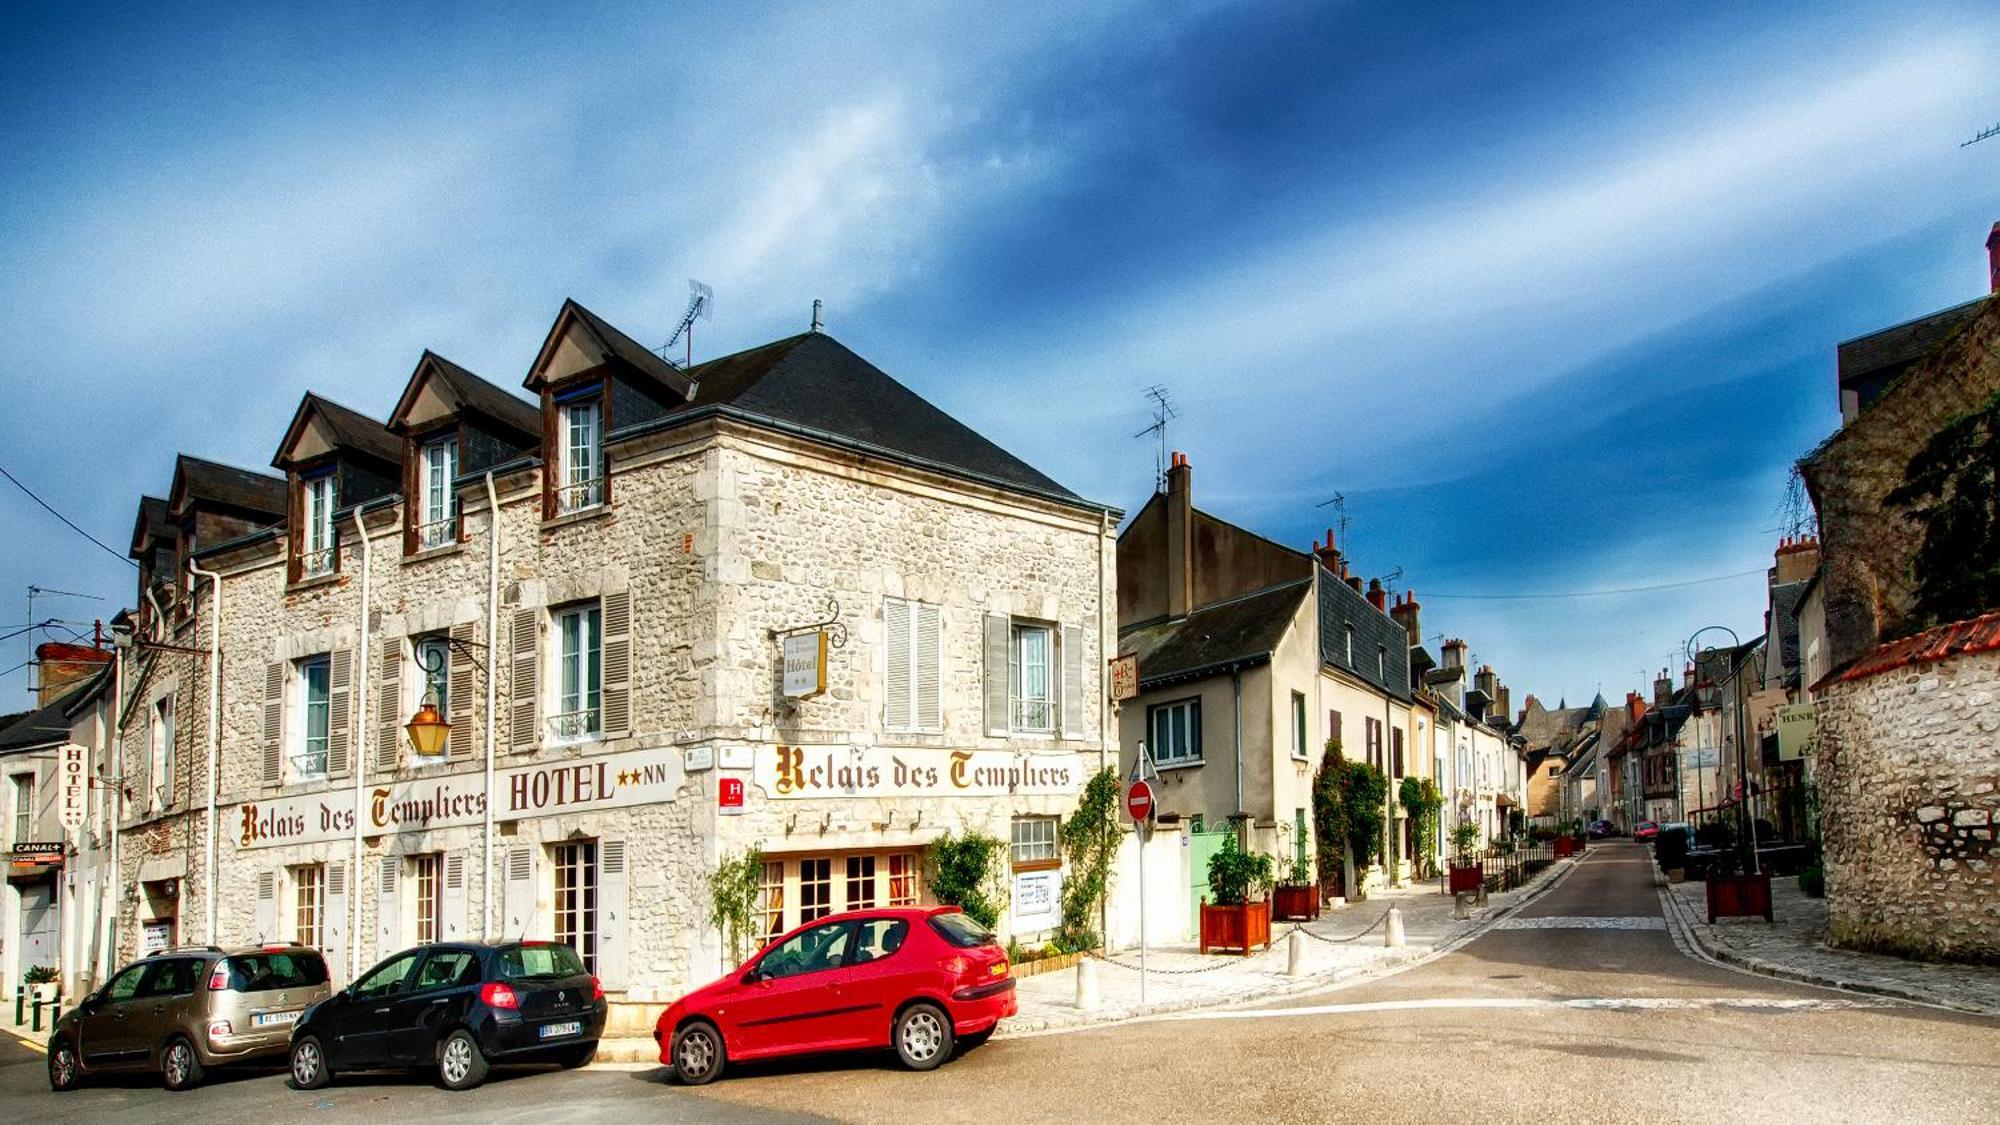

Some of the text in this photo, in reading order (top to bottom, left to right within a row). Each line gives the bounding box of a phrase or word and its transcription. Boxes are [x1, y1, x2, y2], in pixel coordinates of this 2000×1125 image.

[786, 655, 817, 673] Hôtel
[1783, 712, 1815, 723] HENR
[66, 750, 81, 809] HOTEL
[509, 762, 666, 811] HOTEL NN
[776, 746, 1070, 794] Relais des Templiers
[729, 783, 741, 795] H
[240, 785, 488, 847] Relais des Templiers
[16, 844, 61, 853] CANAL+
